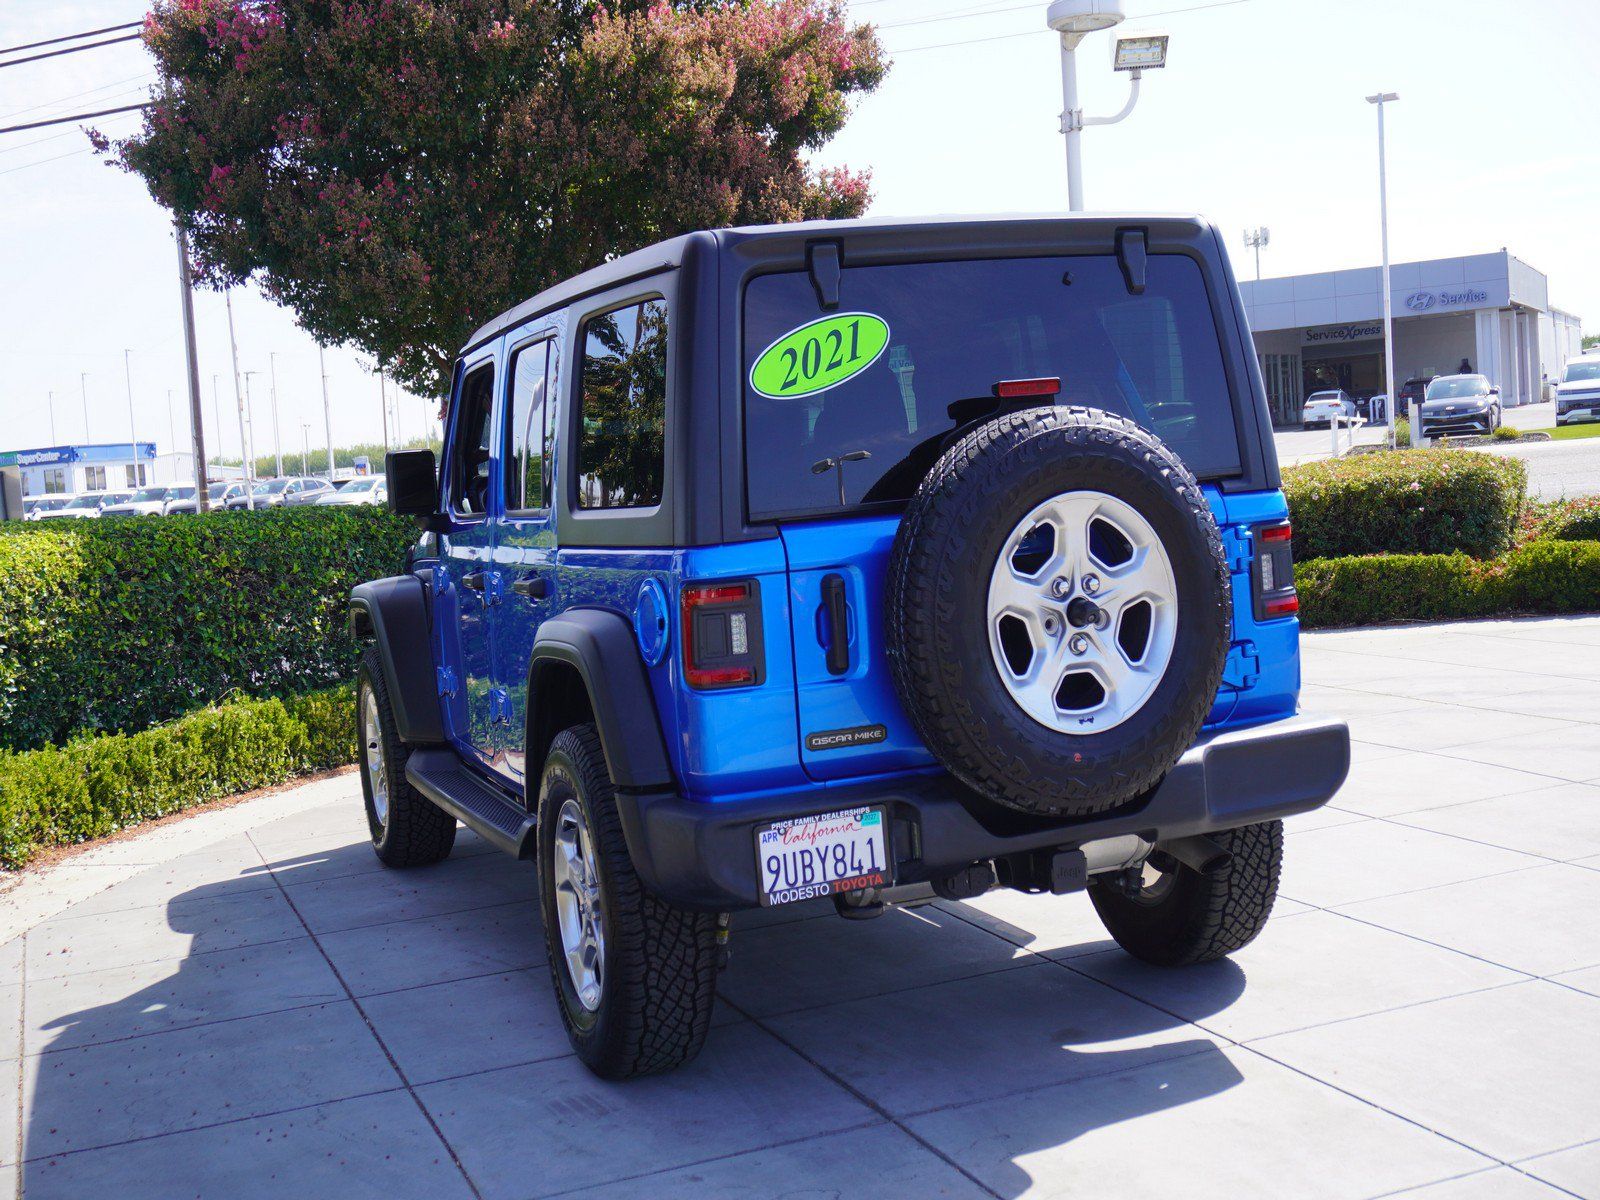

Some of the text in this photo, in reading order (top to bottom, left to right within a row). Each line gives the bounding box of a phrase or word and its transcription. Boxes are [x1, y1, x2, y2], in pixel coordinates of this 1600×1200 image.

[1440, 289, 1487, 305] Service
[780, 319, 862, 391] 2021
[812, 730, 882, 746] OSCAR MIKE
[771, 807, 870, 830] PRICE FAMILY DEALERSHIPS
[762, 832, 778, 844] APR
[782, 822, 862, 845] California
[767, 838, 881, 893] 9UBY841
[769, 873, 884, 905] MODESTO TOYOTA
